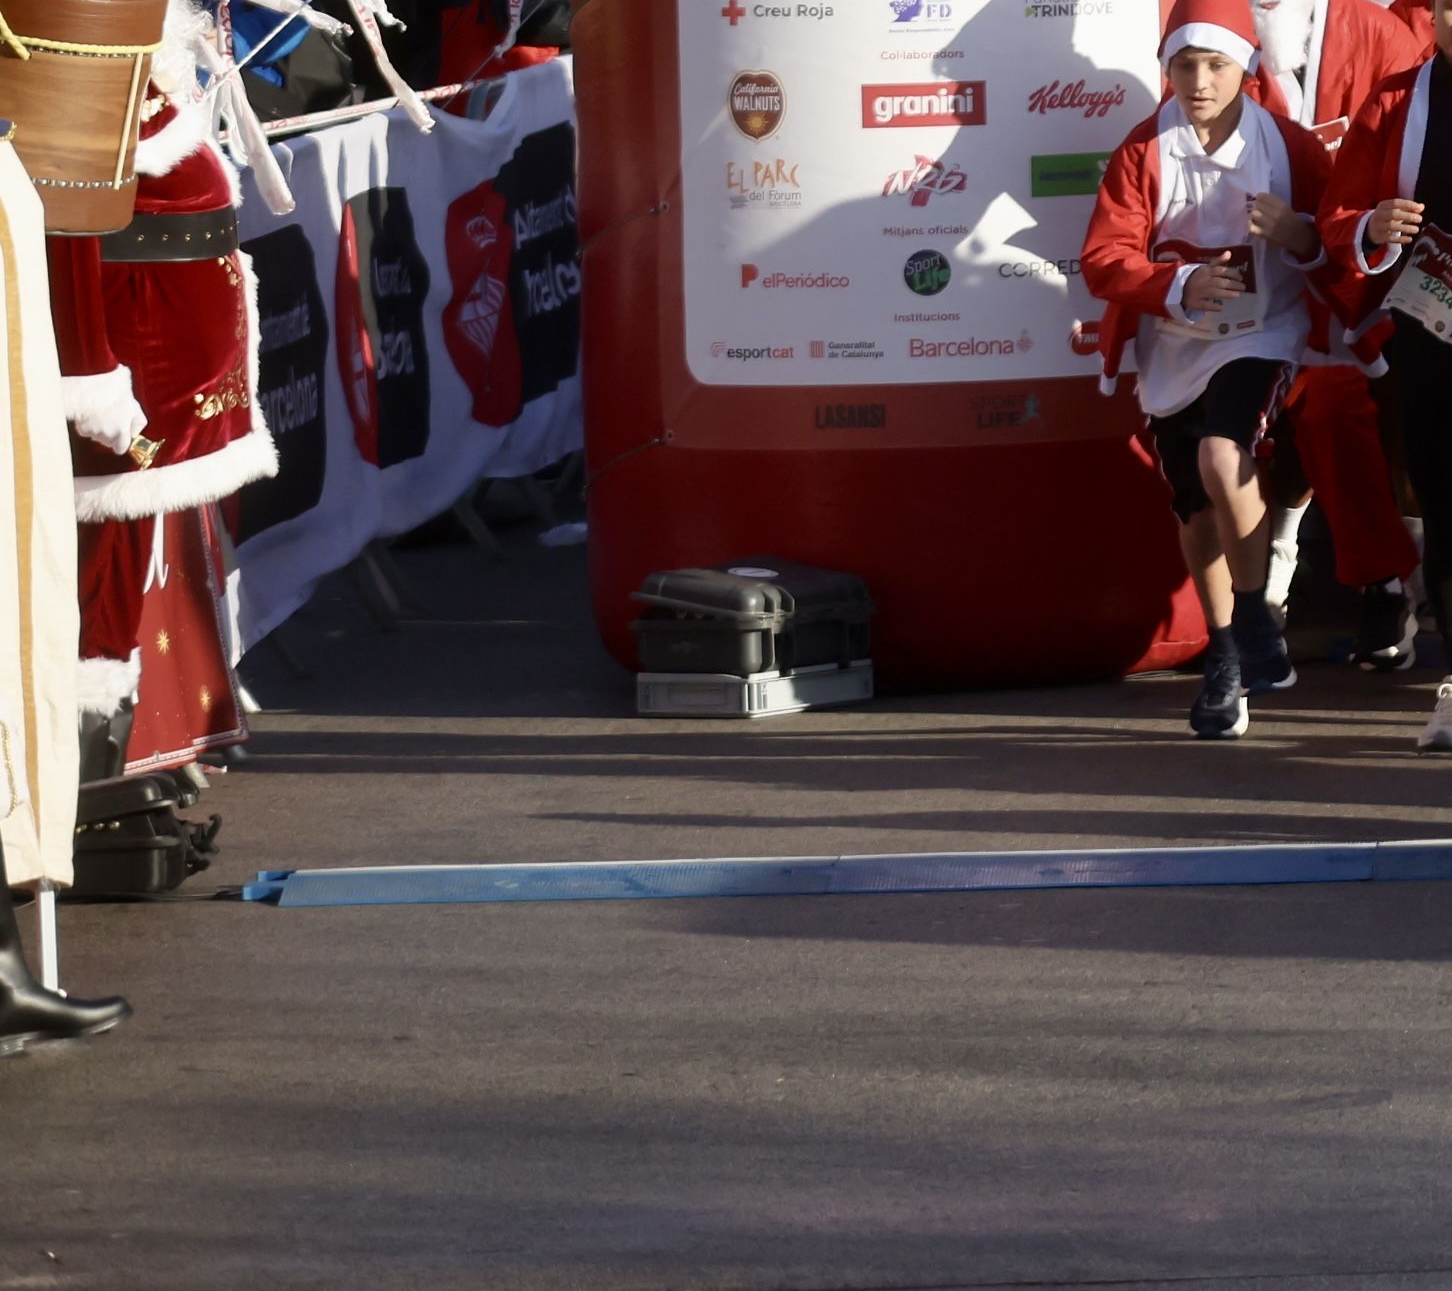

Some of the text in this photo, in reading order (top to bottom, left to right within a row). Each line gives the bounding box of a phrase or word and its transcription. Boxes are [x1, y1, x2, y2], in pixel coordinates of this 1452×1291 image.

[753, 4, 834, 19] Creu Roja
[734, 83, 779, 94] California
[734, 96, 780, 111] WALNUTS
[873, 88, 974, 124] granini
[1028, 80, 1126, 118] Kellogg's
[726, 162, 749, 194] EL
[750, 190, 764, 200] del
[883, 225, 968, 237] Mitjans oficials
[906, 254, 942, 276] Sport
[763, 273, 849, 288] elPeriódico
[895, 313, 960, 322] Institucions
[728, 347, 794, 361] esportcat
[841, 350, 884, 359] Catalunya
[910, 337, 1014, 357] Barcelona
[816, 404, 886, 428] LASANSI
